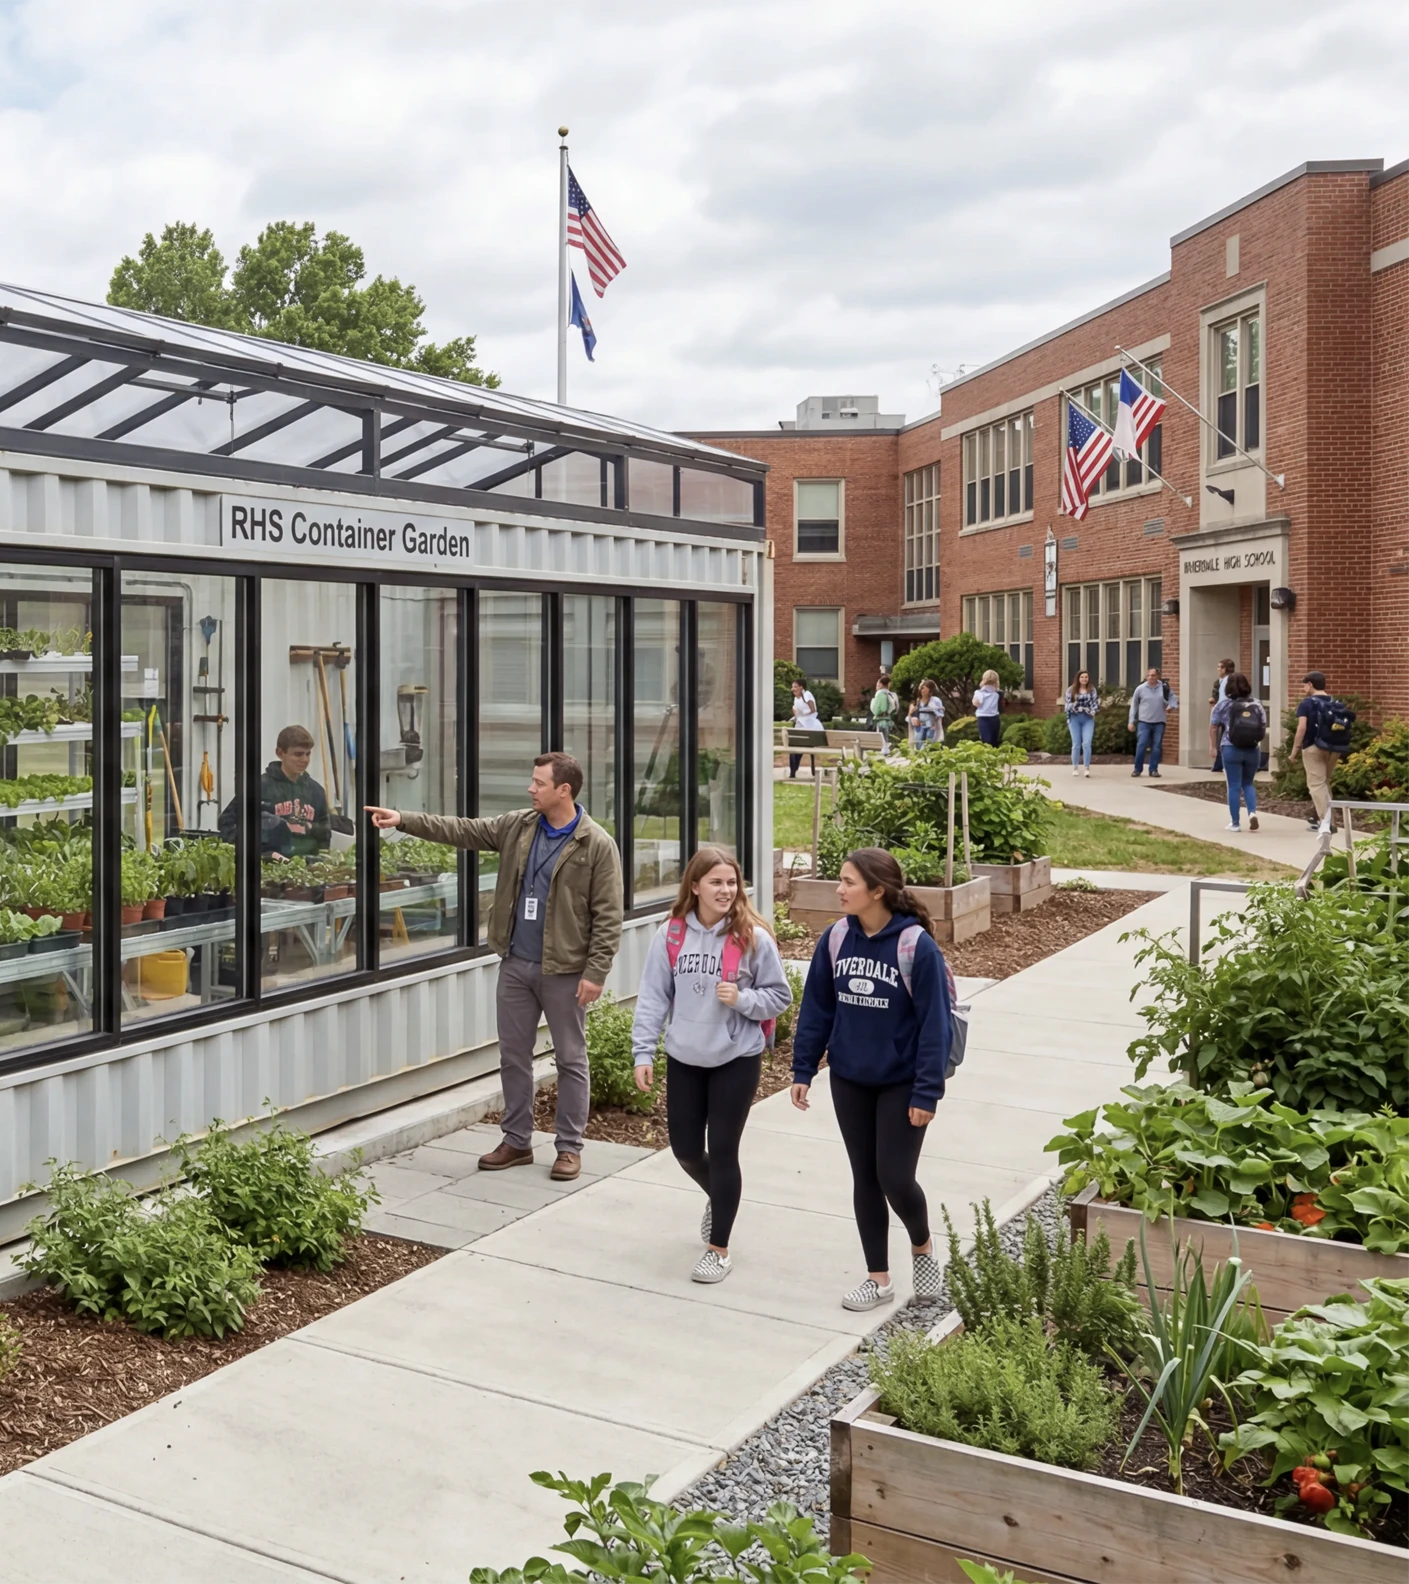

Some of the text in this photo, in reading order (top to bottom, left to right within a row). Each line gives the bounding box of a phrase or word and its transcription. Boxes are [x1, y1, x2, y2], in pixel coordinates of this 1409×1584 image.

[231, 505, 470, 558] RHS Container Garden
[835, 956, 899, 988] IVERDALE
